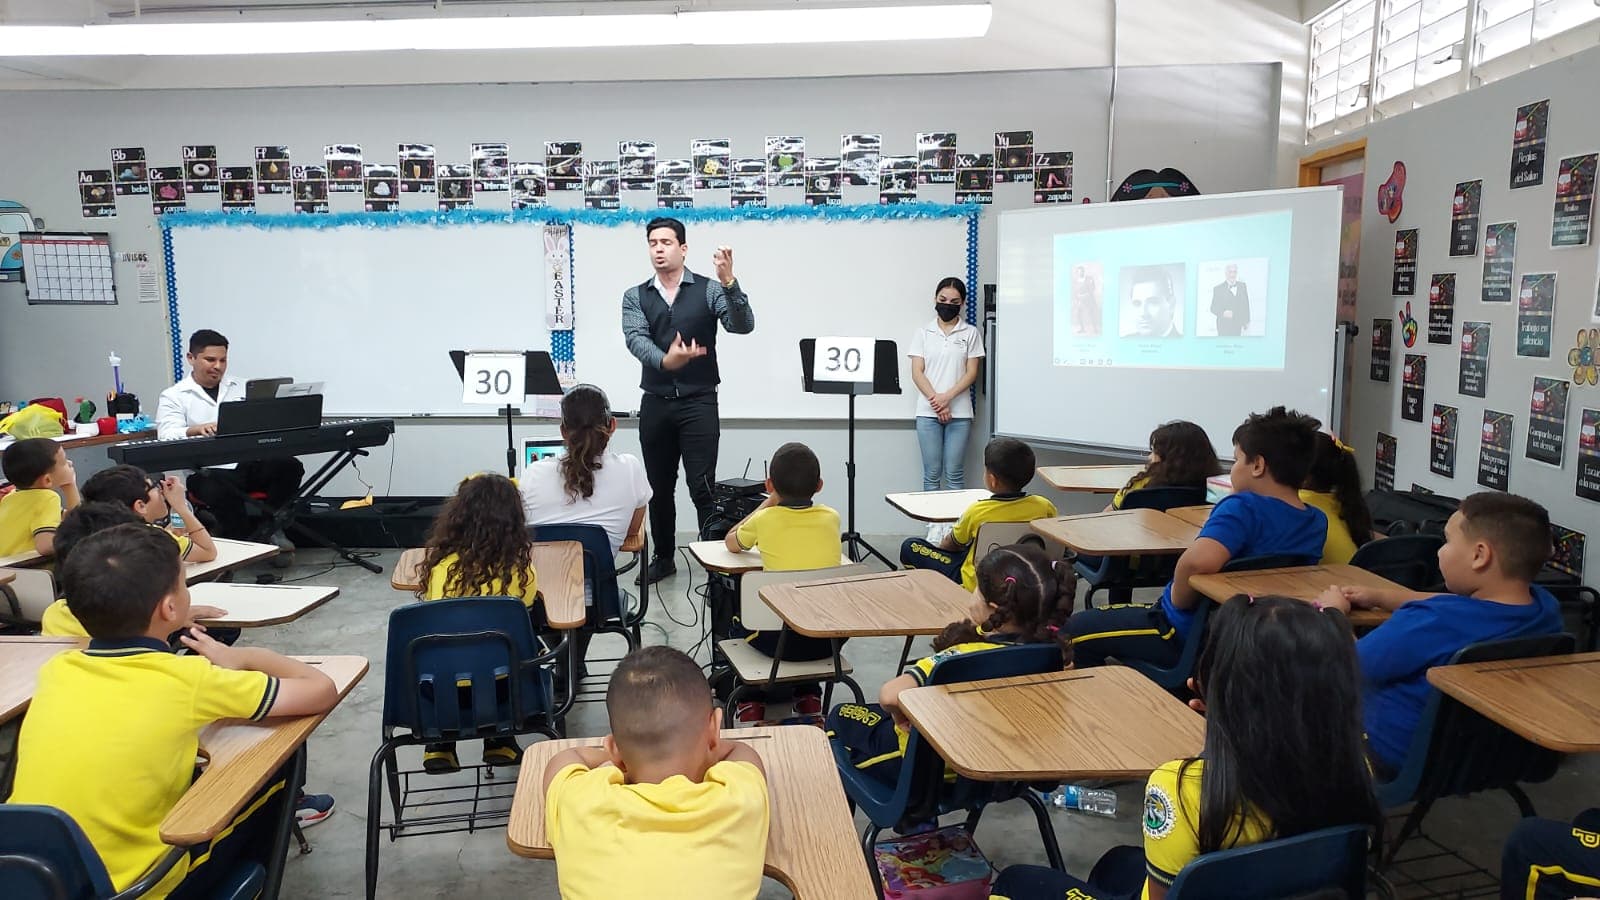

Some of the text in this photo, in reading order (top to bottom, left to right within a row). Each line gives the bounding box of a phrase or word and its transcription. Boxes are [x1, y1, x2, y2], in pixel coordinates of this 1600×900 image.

[996, 133, 1010, 148] Yy
[112, 149, 126, 161] Bb
[183, 147, 197, 159] Dd
[1036, 153, 1050, 166] Zz
[957, 155, 972, 167] Xx
[80, 173, 93, 183] Aa
[554, 272, 564, 324] EASTER
[825, 346, 862, 372] 30
[475, 370, 512, 394] 30
